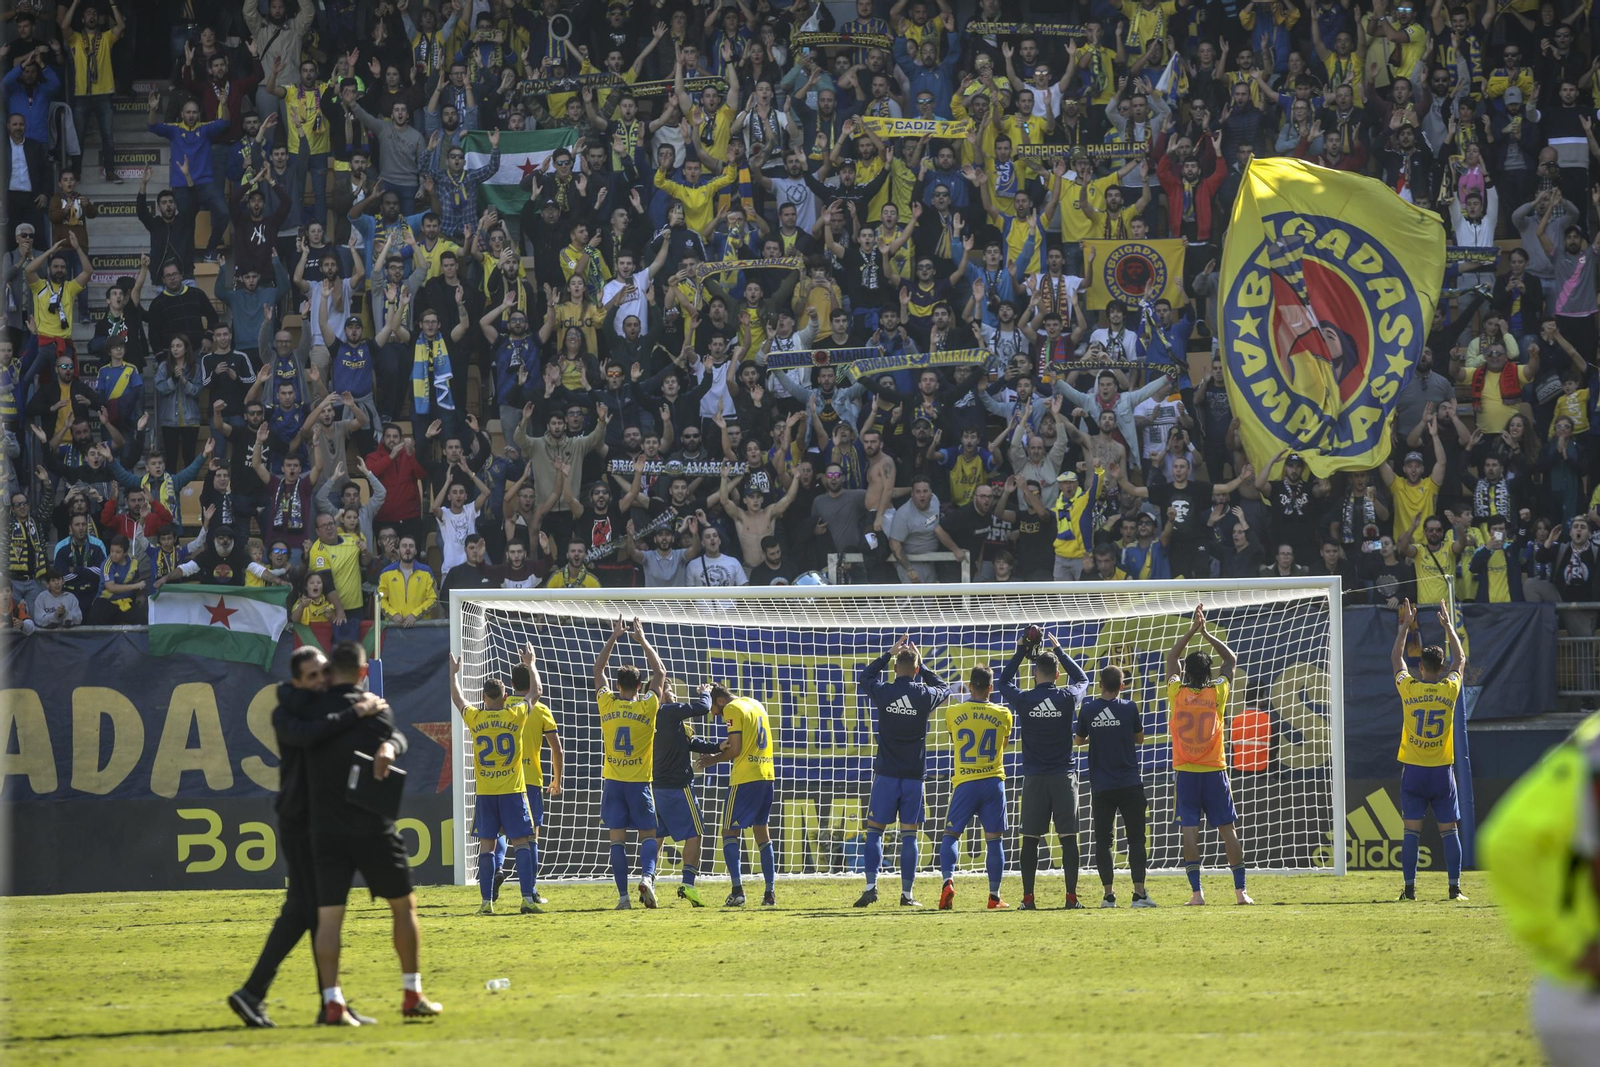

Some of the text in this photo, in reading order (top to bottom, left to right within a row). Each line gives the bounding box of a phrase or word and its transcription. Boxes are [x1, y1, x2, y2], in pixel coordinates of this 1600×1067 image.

[113, 153, 157, 166] uzcampo
[97, 204, 152, 214] Cruzcam
[92, 257, 144, 268] Cruzcamp
[1107, 245, 1164, 269] BRIGADAS
[856, 349, 989, 373] BRIGADAS AMARILLAS
[611, 459, 747, 475] BRIGDAS AMARILAS
[622, 710, 651, 726] CORREA
[885, 705, 918, 716] adidas
[1028, 710, 1062, 718] adidas
[490, 720, 519, 733] VALLEJO
[954, 712, 1002, 728] EDU RAMOS
[1091, 719, 1121, 728] adidas
[1176, 710, 1217, 745] 20
[1410, 708, 1447, 739] 15
[757, 716, 768, 750] 6
[613, 726, 634, 758] 4
[956, 728, 998, 764] 24
[1408, 734, 1443, 749] Bayport
[475, 732, 516, 769] 29
[606, 754, 643, 767] Bayport
[480, 767, 516, 779] Bayport
[1312, 840, 1433, 868] adidas
